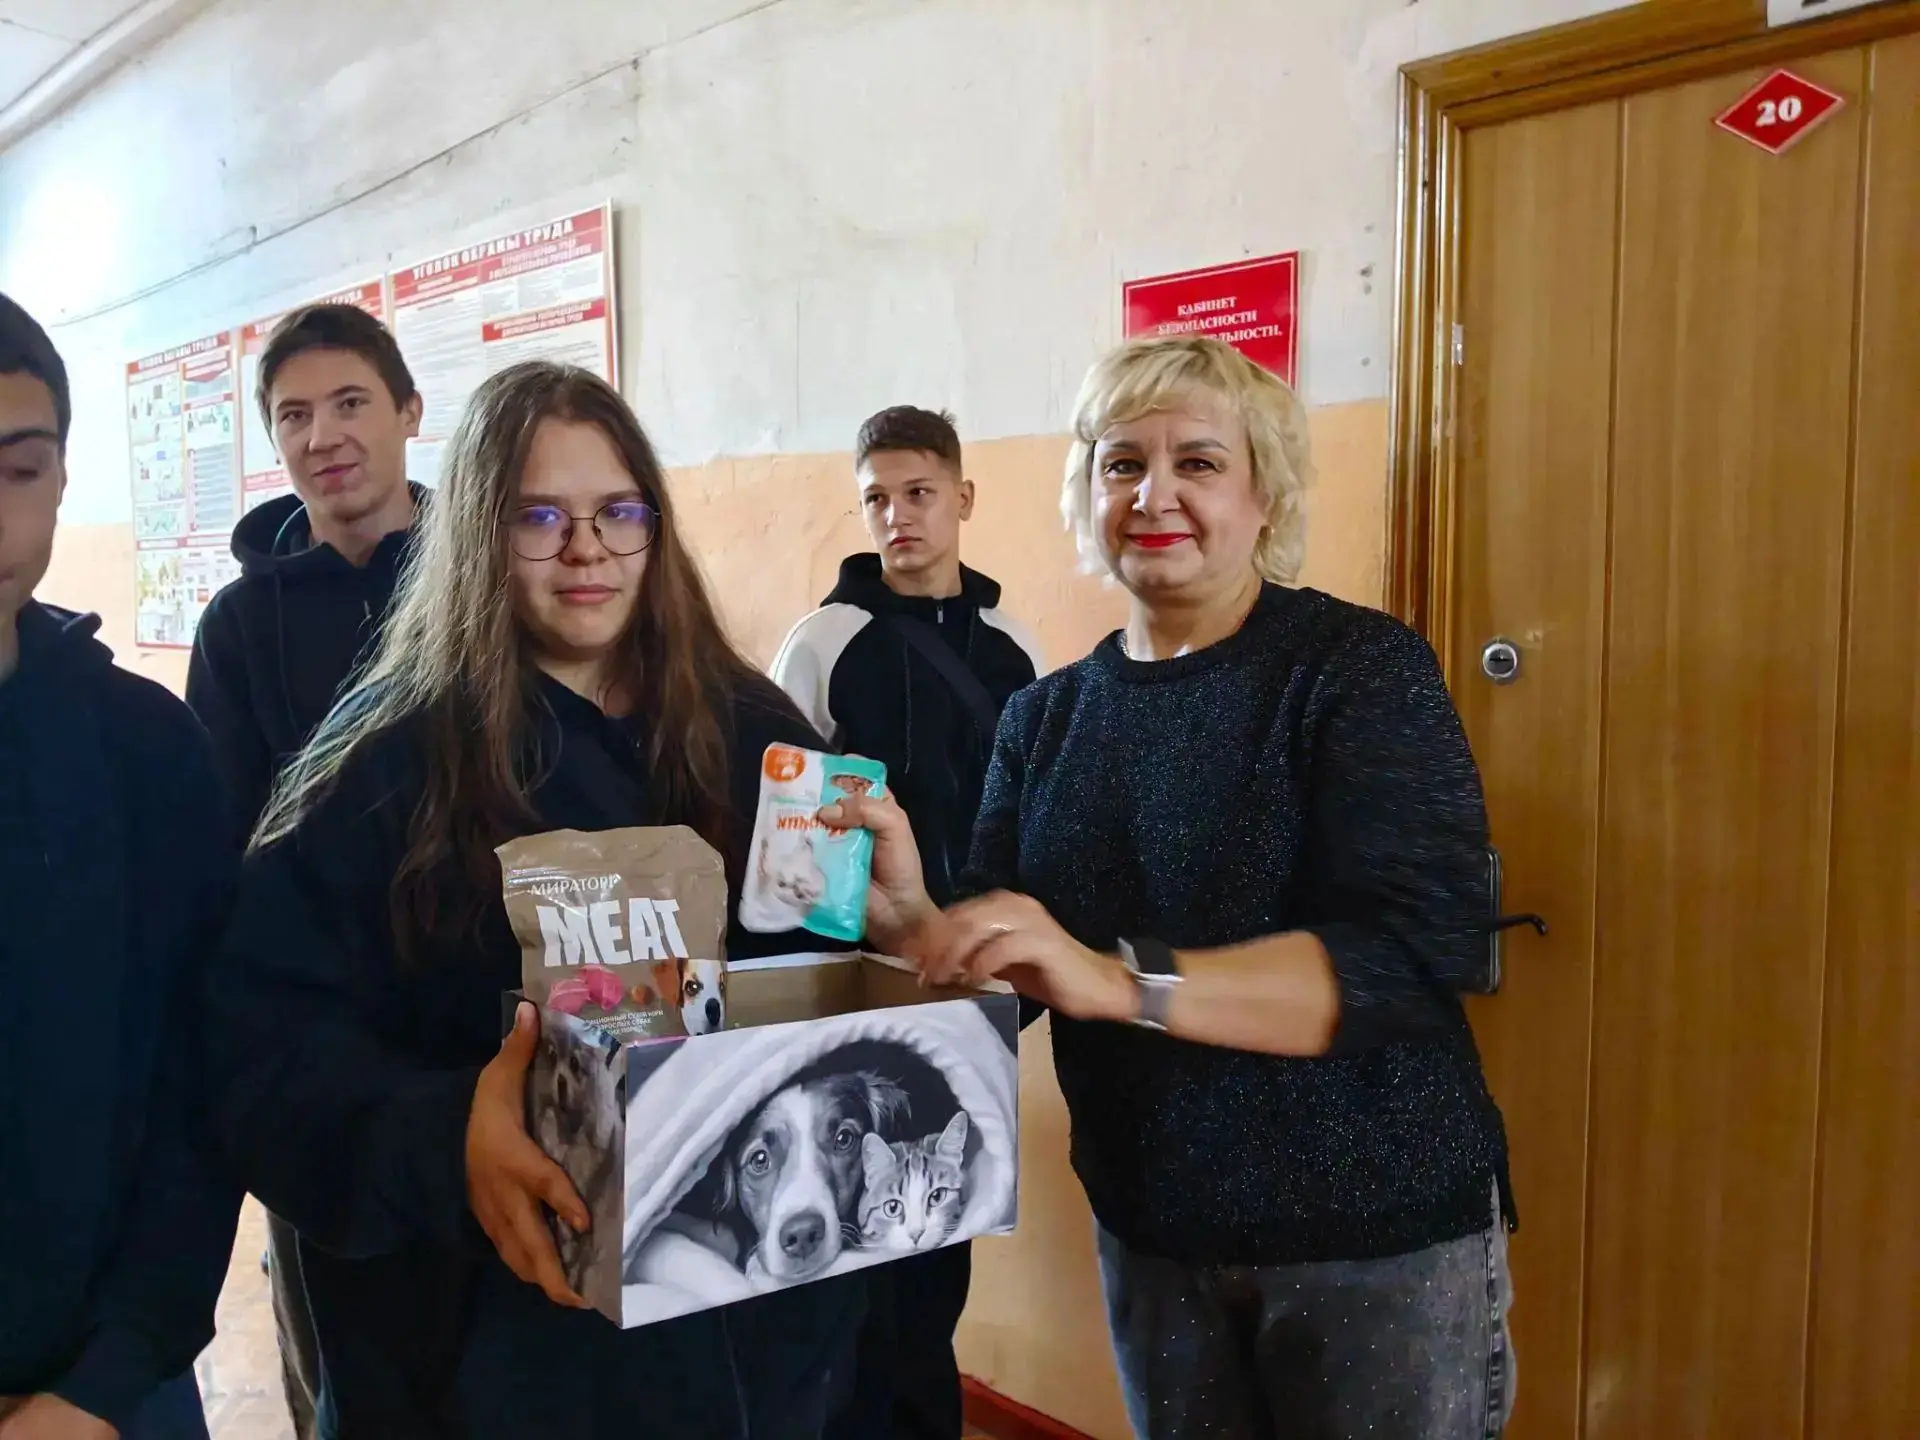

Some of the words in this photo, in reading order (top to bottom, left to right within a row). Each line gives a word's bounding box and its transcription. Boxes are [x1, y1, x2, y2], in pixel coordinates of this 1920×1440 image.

[1755, 95, 1802, 127] 20
[461, 235, 521, 265] ОХРАНЫ
[523, 219, 574, 246] ТРУДА
[1177, 296, 1237, 315] КАБИНЕТ
[1158, 310, 1257, 335] БЕЗОПАСНОСТИ
[535, 897, 689, 967] MEAT
